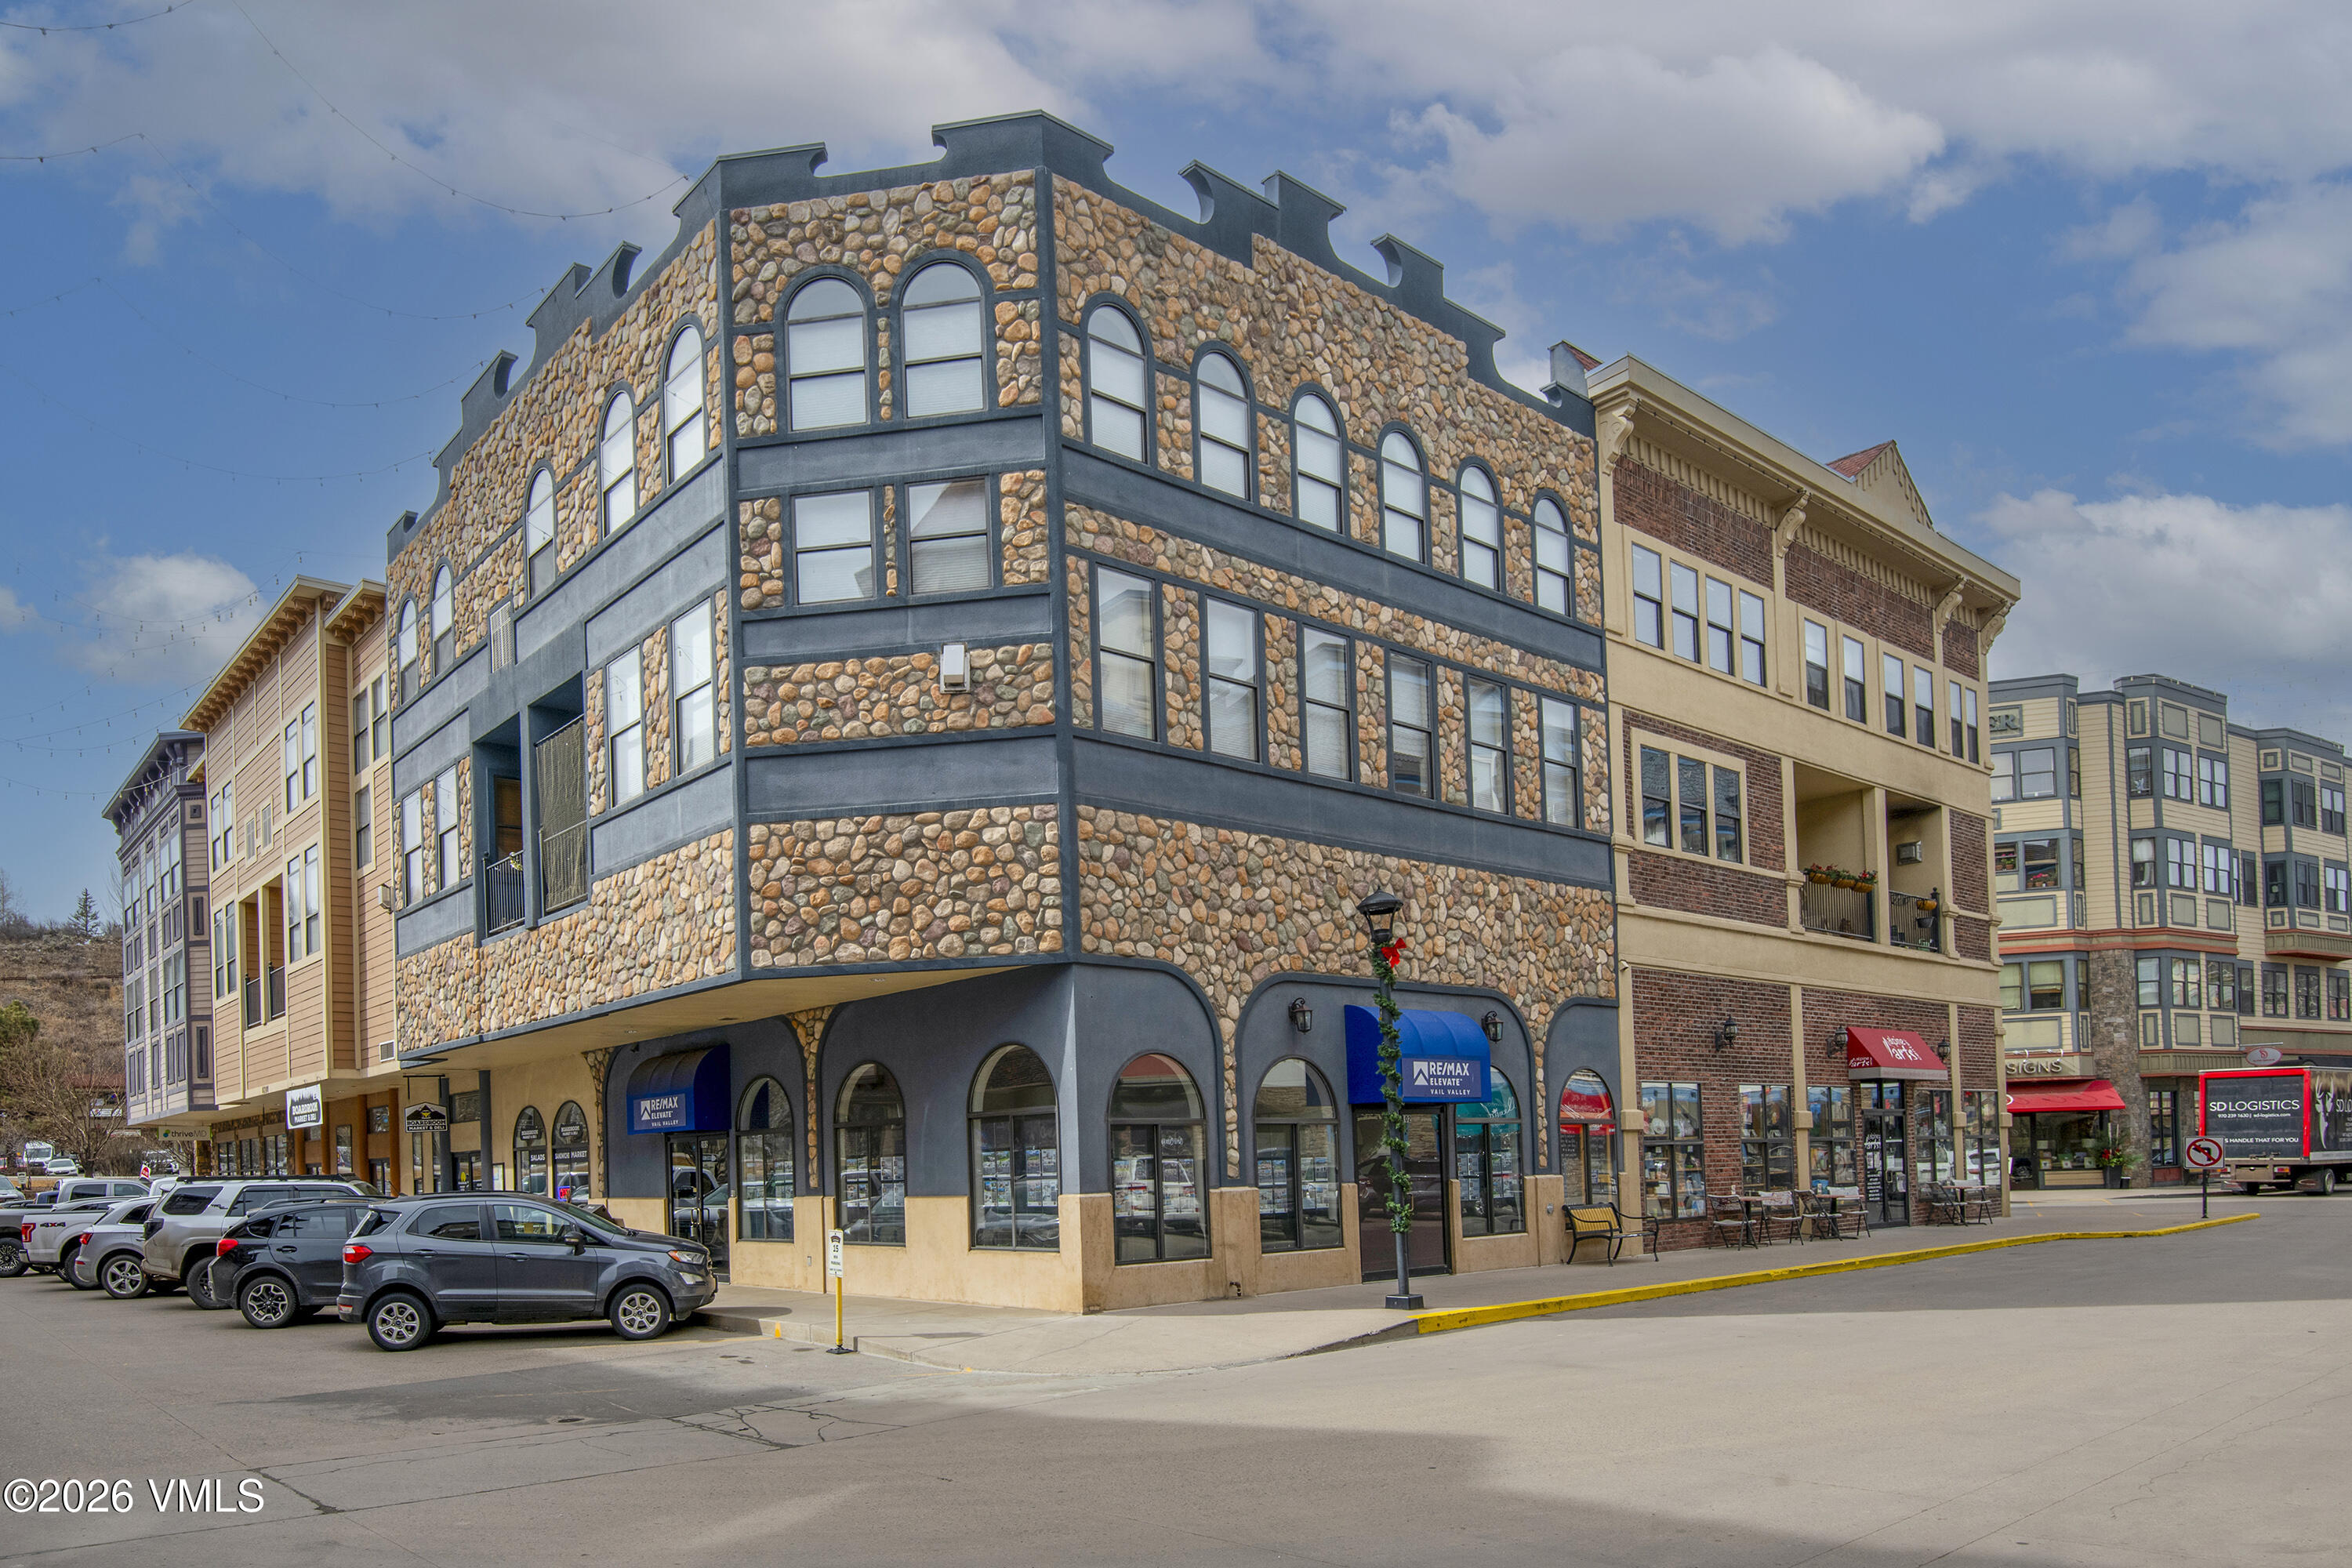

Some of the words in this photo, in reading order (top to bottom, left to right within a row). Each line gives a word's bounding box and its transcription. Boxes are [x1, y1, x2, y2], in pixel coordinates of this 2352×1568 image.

[1429, 1062, 1470, 1076] RE/MAX
[1430, 1077, 1461, 1086] ELEVATE
[651, 1096, 678, 1111] RE/MAX
[2209, 1102, 2227, 1112] SD
[2229, 1099, 2300, 1111] LOGISTICS
[2336, 1098, 2344, 1112] SD
[651, 1111, 673, 1120] ELEVATE
[571, 1150, 588, 1159] MARKET
[833, 1244, 839, 1253] 15
